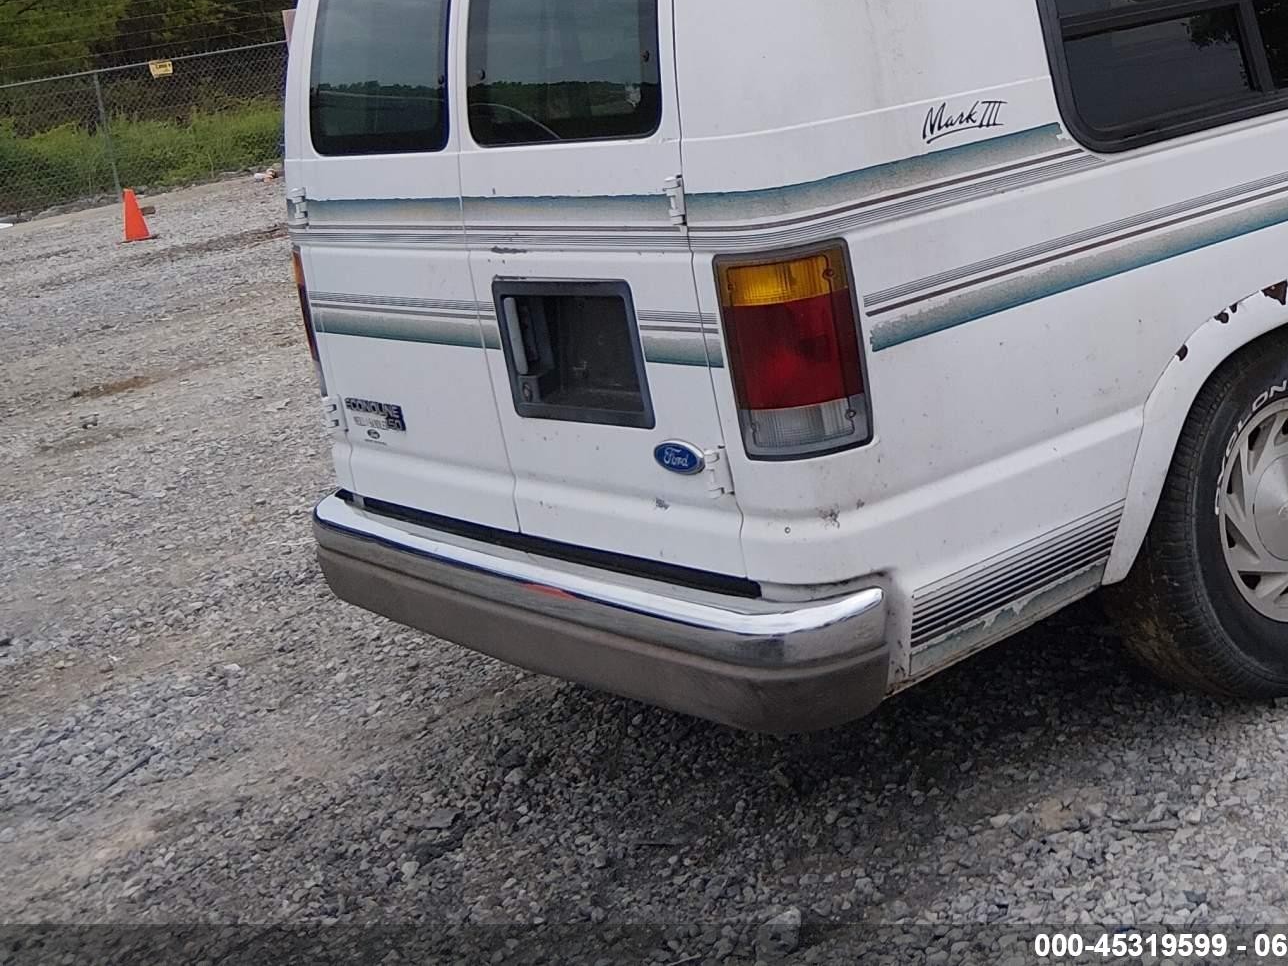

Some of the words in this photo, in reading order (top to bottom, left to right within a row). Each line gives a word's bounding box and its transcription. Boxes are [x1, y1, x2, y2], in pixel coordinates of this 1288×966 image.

[922, 100, 979, 140] Mark
[978, 100, 1009, 129] III
[663, 447, 690, 467] Ford
